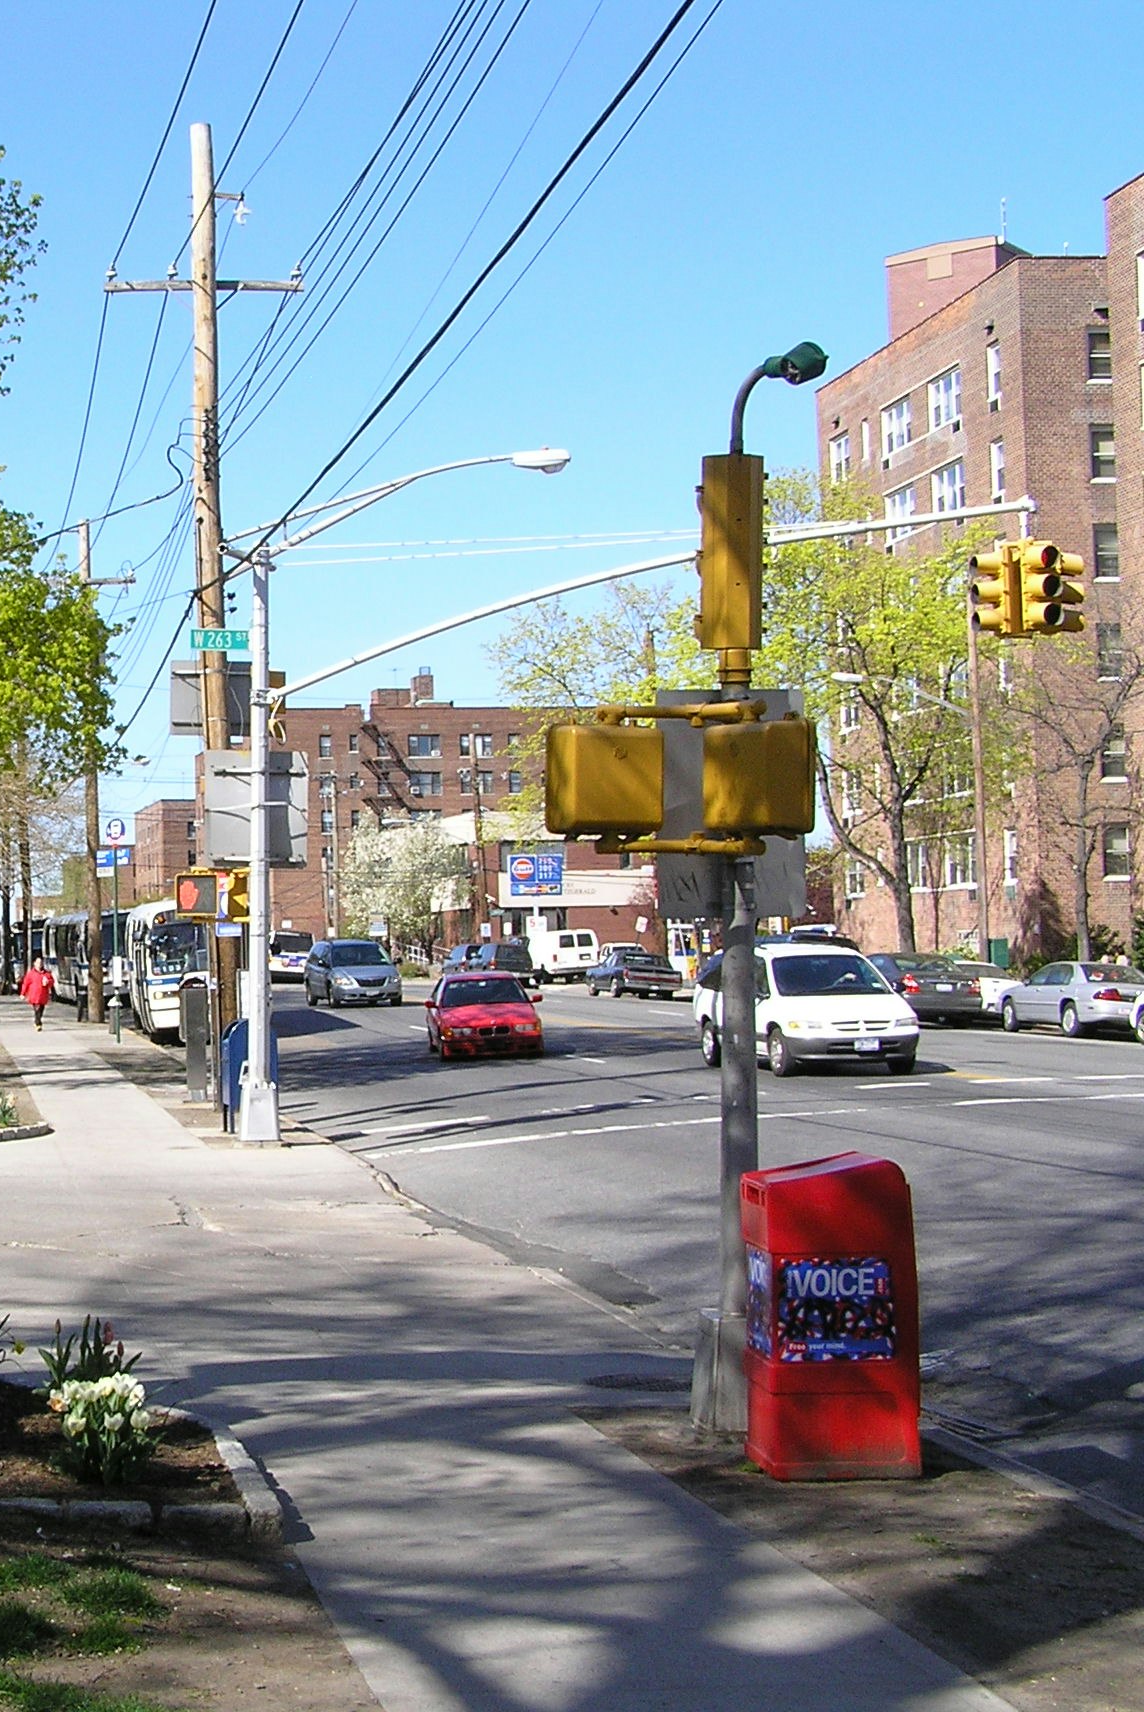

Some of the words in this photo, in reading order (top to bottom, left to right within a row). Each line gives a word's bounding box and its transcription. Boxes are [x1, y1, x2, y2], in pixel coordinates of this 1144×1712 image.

[194, 631, 205, 647] W
[207, 631, 232, 648] 263
[236, 631, 247, 641] ST
[793, 1268, 875, 1297] VOICE
[788, 1343, 807, 1351] Free
